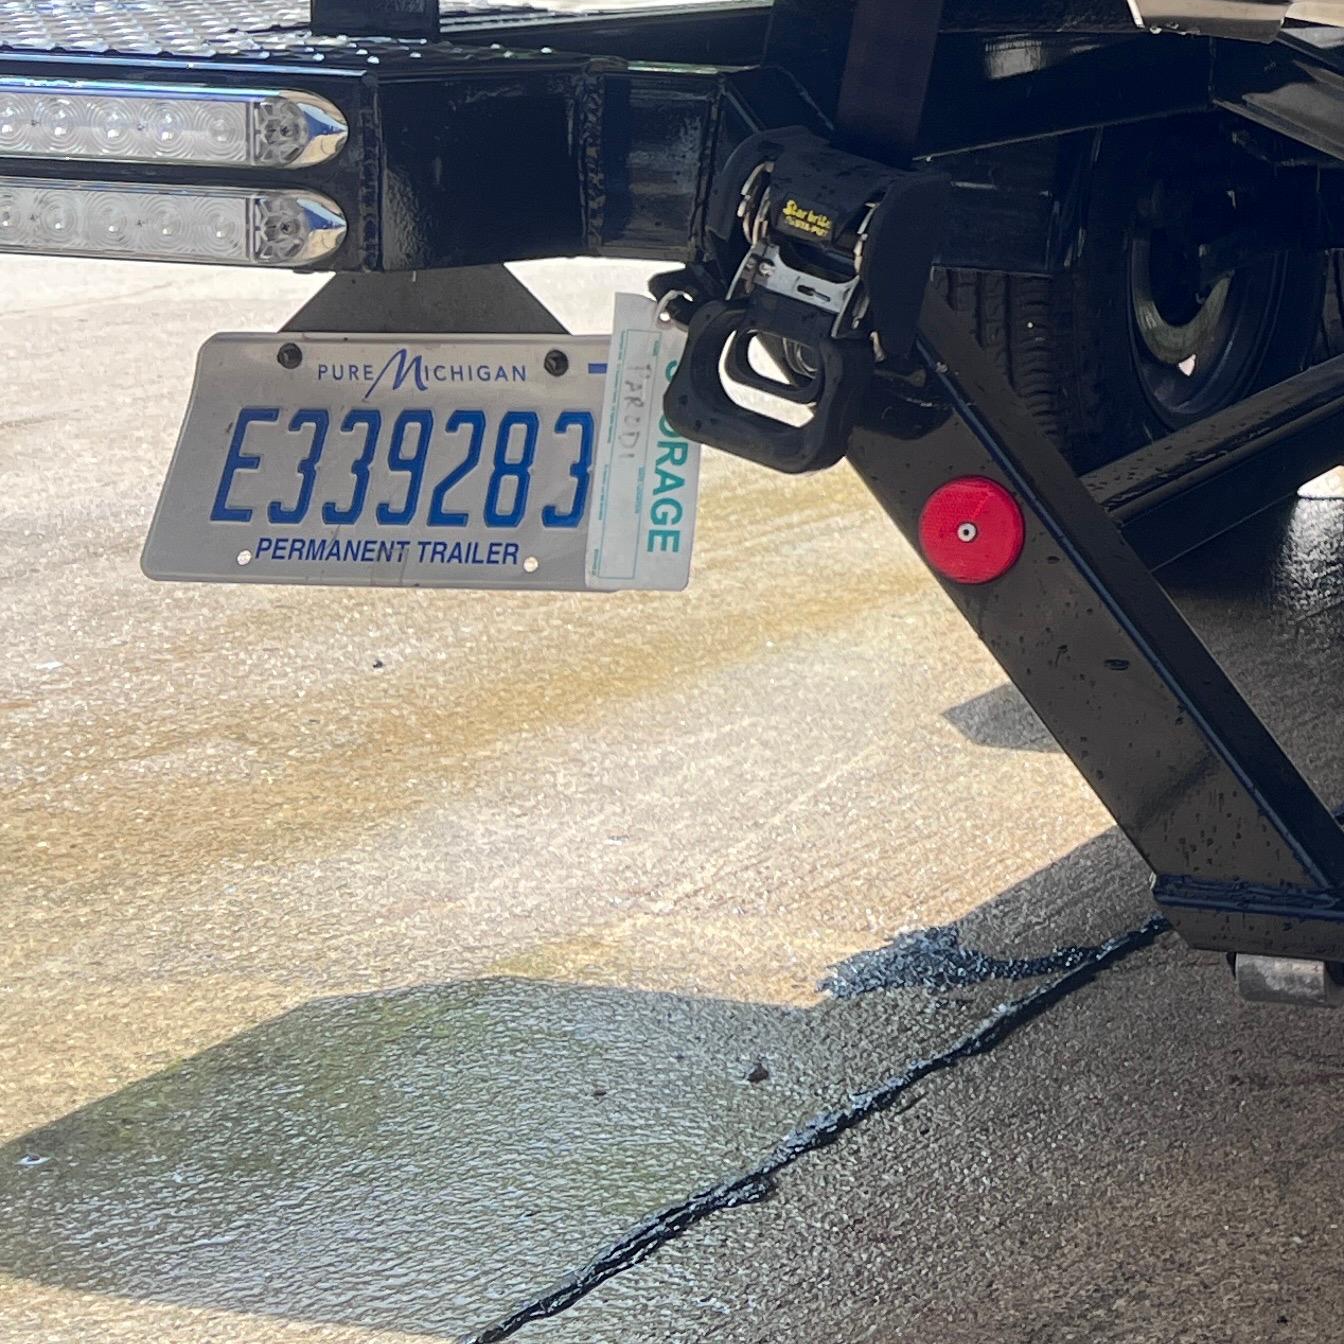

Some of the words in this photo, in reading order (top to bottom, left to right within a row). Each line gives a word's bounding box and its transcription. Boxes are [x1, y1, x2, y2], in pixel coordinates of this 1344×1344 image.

[317, 363, 374, 383] PURE
[364, 347, 527, 401] MICHIGAN
[210, 406, 595, 529] E339283
[254, 537, 411, 564] PERMANENT
[416, 540, 520, 567] TRAILER
